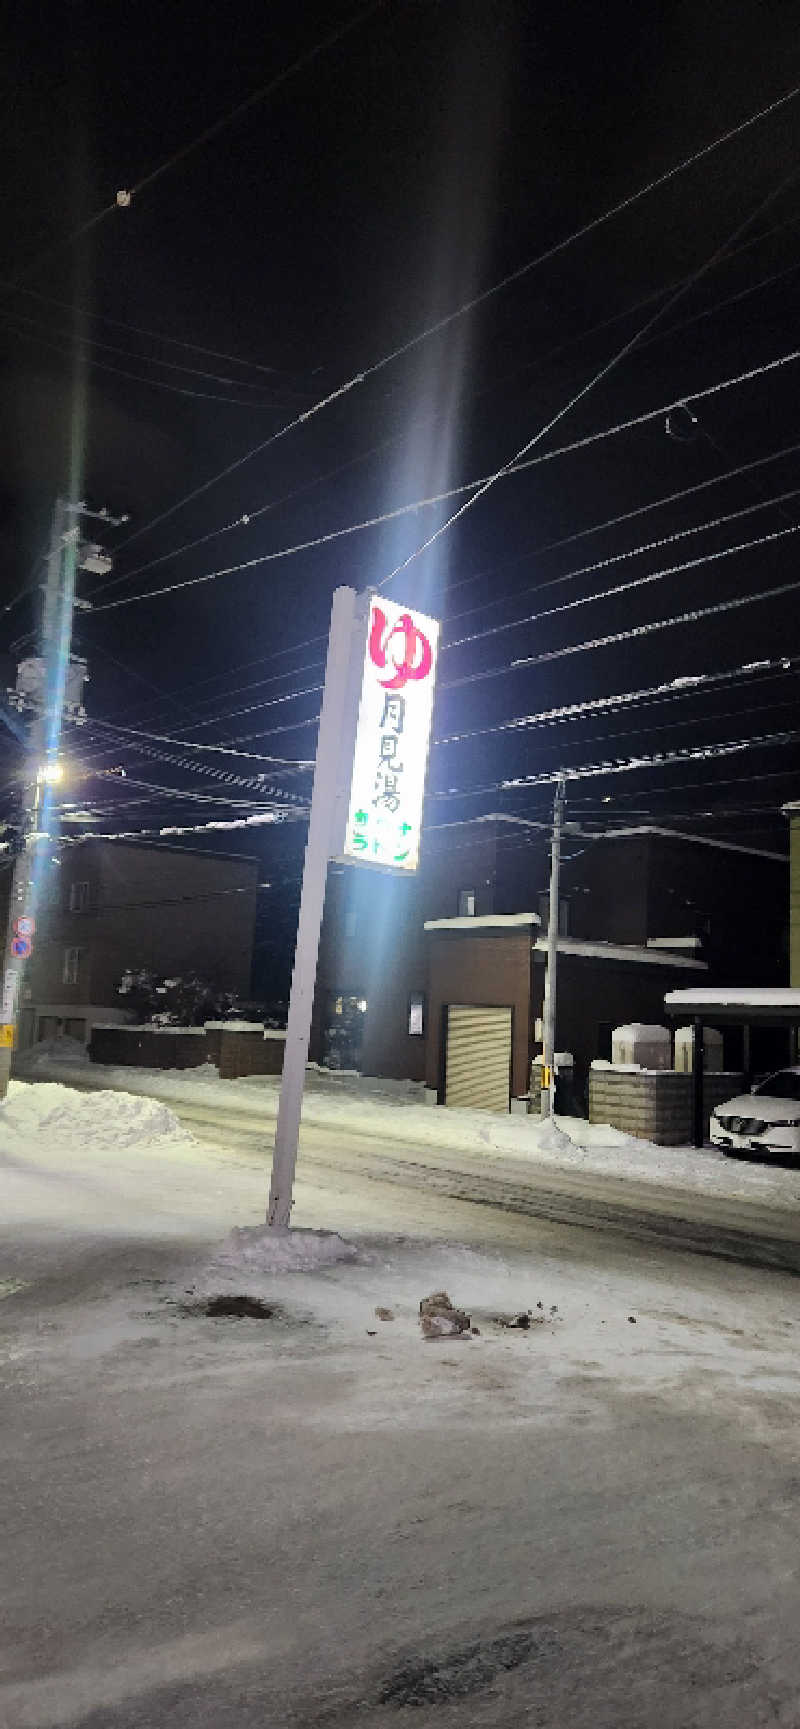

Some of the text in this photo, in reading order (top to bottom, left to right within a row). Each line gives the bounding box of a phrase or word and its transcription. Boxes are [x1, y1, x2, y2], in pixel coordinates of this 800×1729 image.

[369, 607, 433, 689] ゆ
[372, 691, 406, 813] 月見湯
